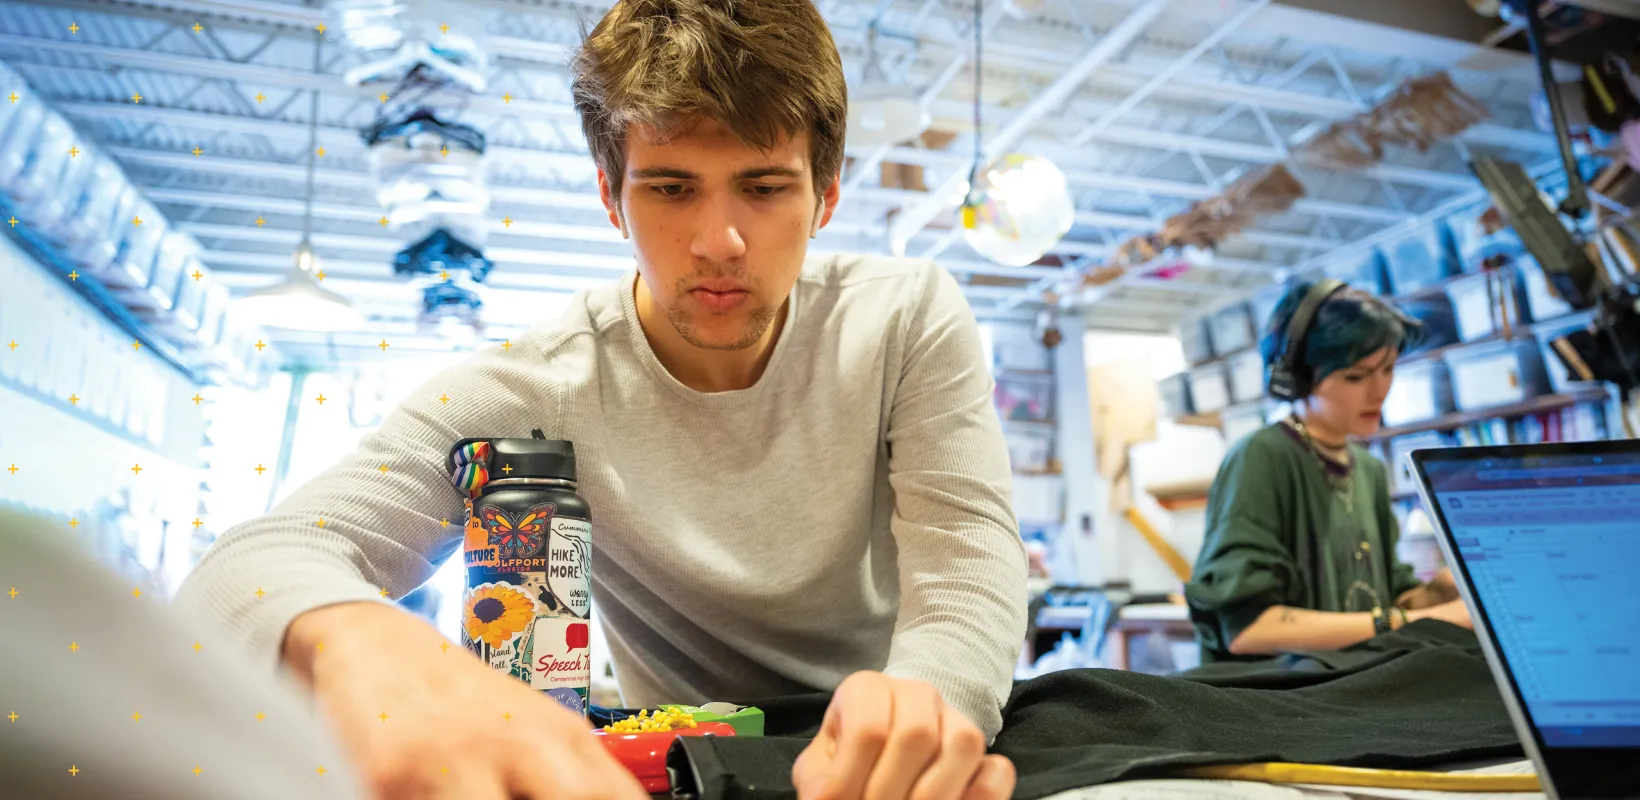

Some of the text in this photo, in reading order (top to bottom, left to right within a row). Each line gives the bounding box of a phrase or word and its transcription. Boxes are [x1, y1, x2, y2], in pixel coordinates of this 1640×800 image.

[551, 549, 575, 562] HIKE
[490, 645, 511, 658] stand
[535, 652, 582, 678] Speech
